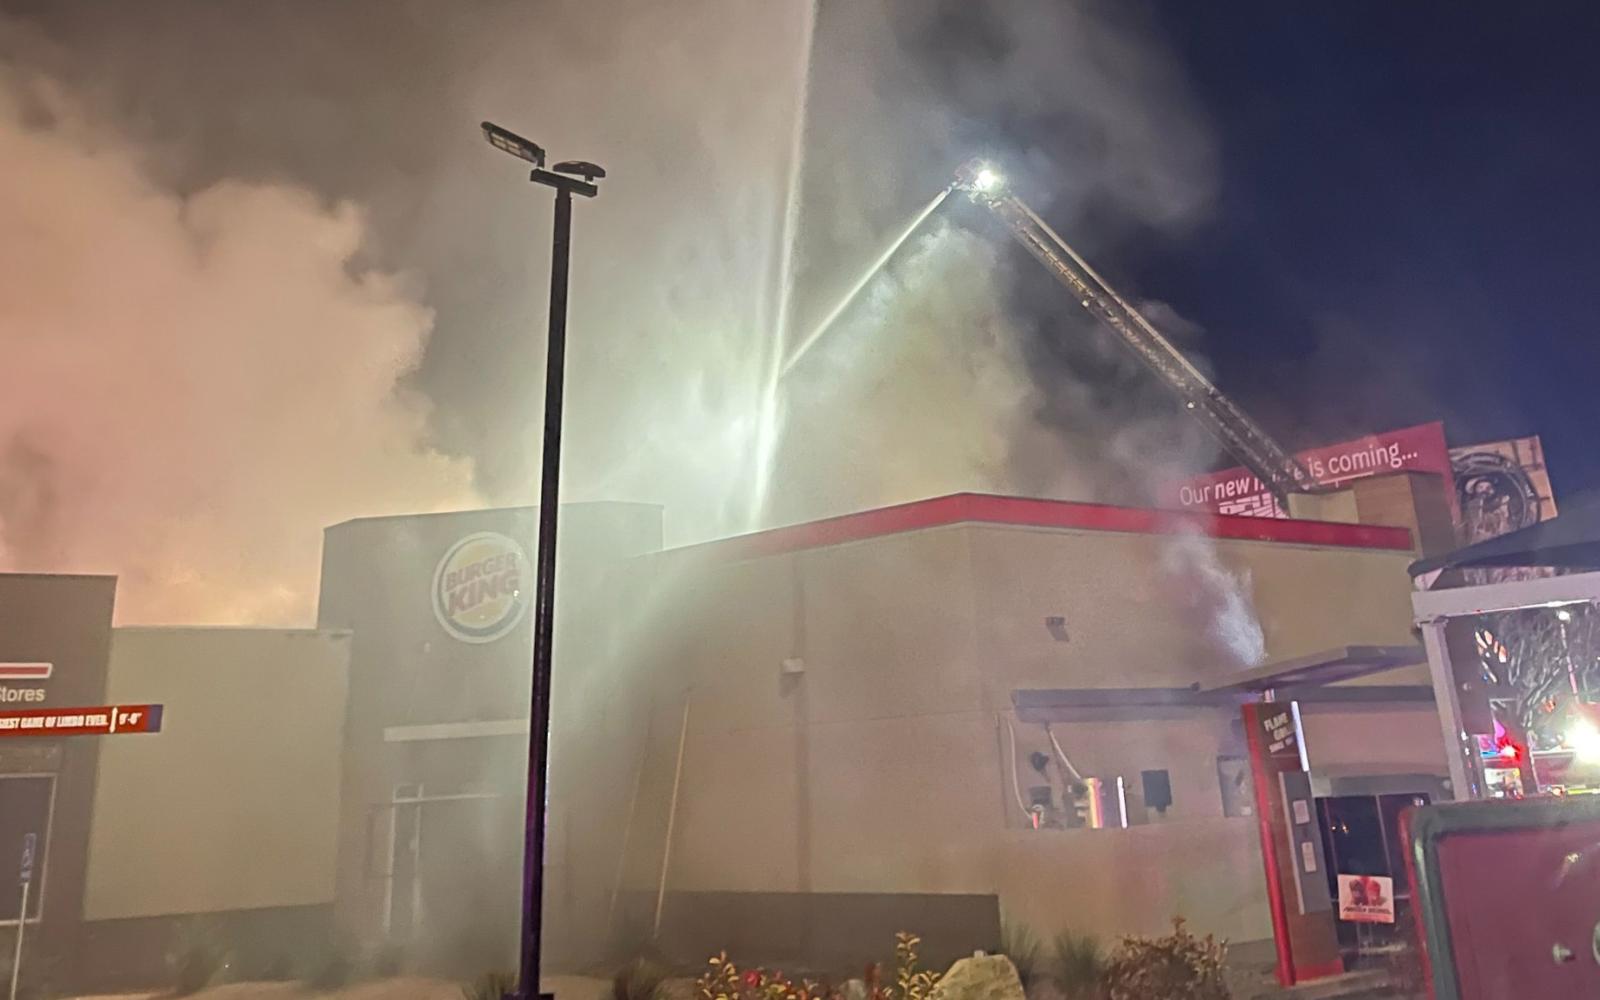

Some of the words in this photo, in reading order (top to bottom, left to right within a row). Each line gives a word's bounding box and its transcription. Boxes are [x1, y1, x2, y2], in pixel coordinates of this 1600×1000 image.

[1179, 485, 1211, 506] Our
[1215, 477, 1250, 499] new
[1308, 457, 1324, 478] is
[446, 552, 517, 592] BURGER
[448, 569, 521, 616] KING
